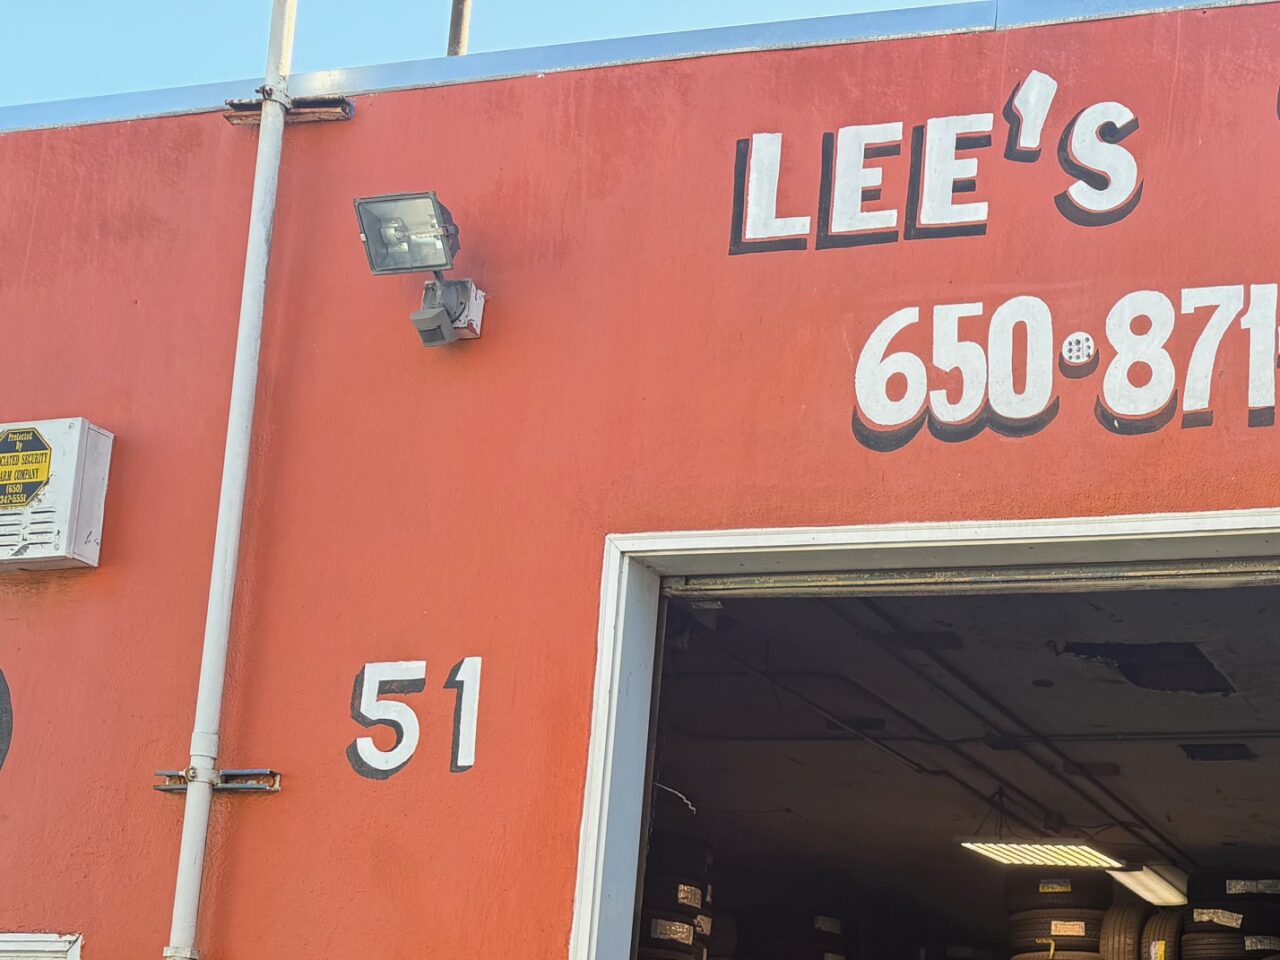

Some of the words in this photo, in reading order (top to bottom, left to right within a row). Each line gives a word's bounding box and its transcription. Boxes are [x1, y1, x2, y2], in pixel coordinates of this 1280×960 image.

[730, 70, 1143, 255] LEE'S
[0, 454, 20, 467] CIATED
[21, 453, 48, 465] SECURITY
[0, 469, 13, 481] ARM
[14, 468, 39, 480] COMPANY
[347, 656, 483, 780] 51
